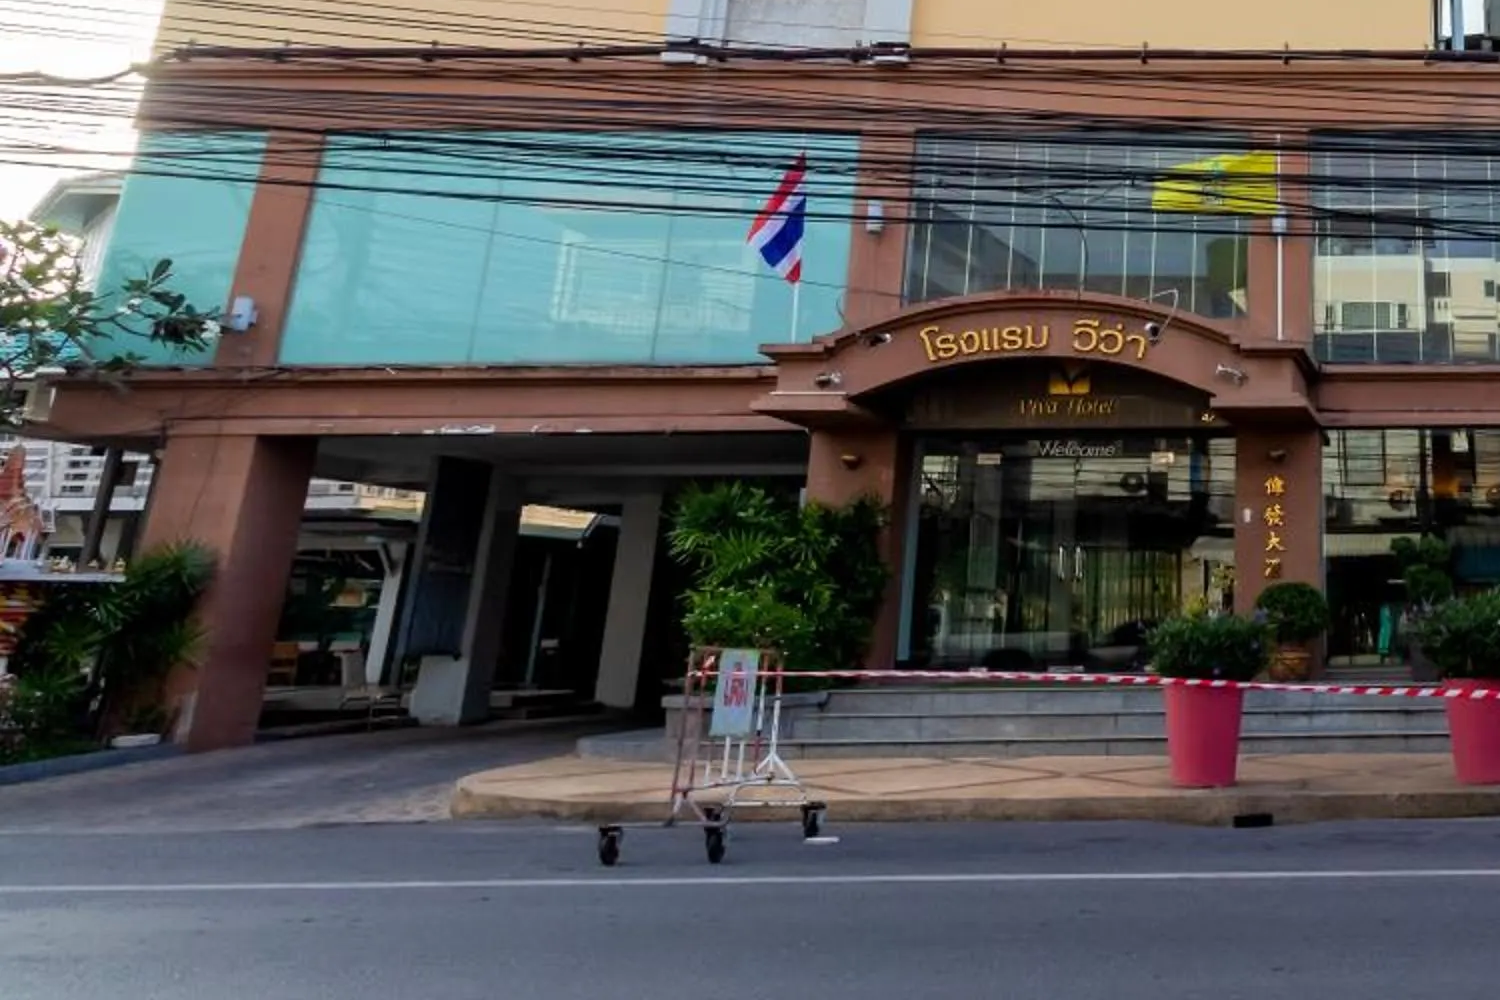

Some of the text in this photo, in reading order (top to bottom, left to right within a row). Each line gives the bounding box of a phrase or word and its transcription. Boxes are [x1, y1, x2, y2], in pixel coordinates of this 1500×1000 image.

[919, 319, 1148, 361] โรงแรม วีว่า
[1039, 440, 1116, 457] Welcome
